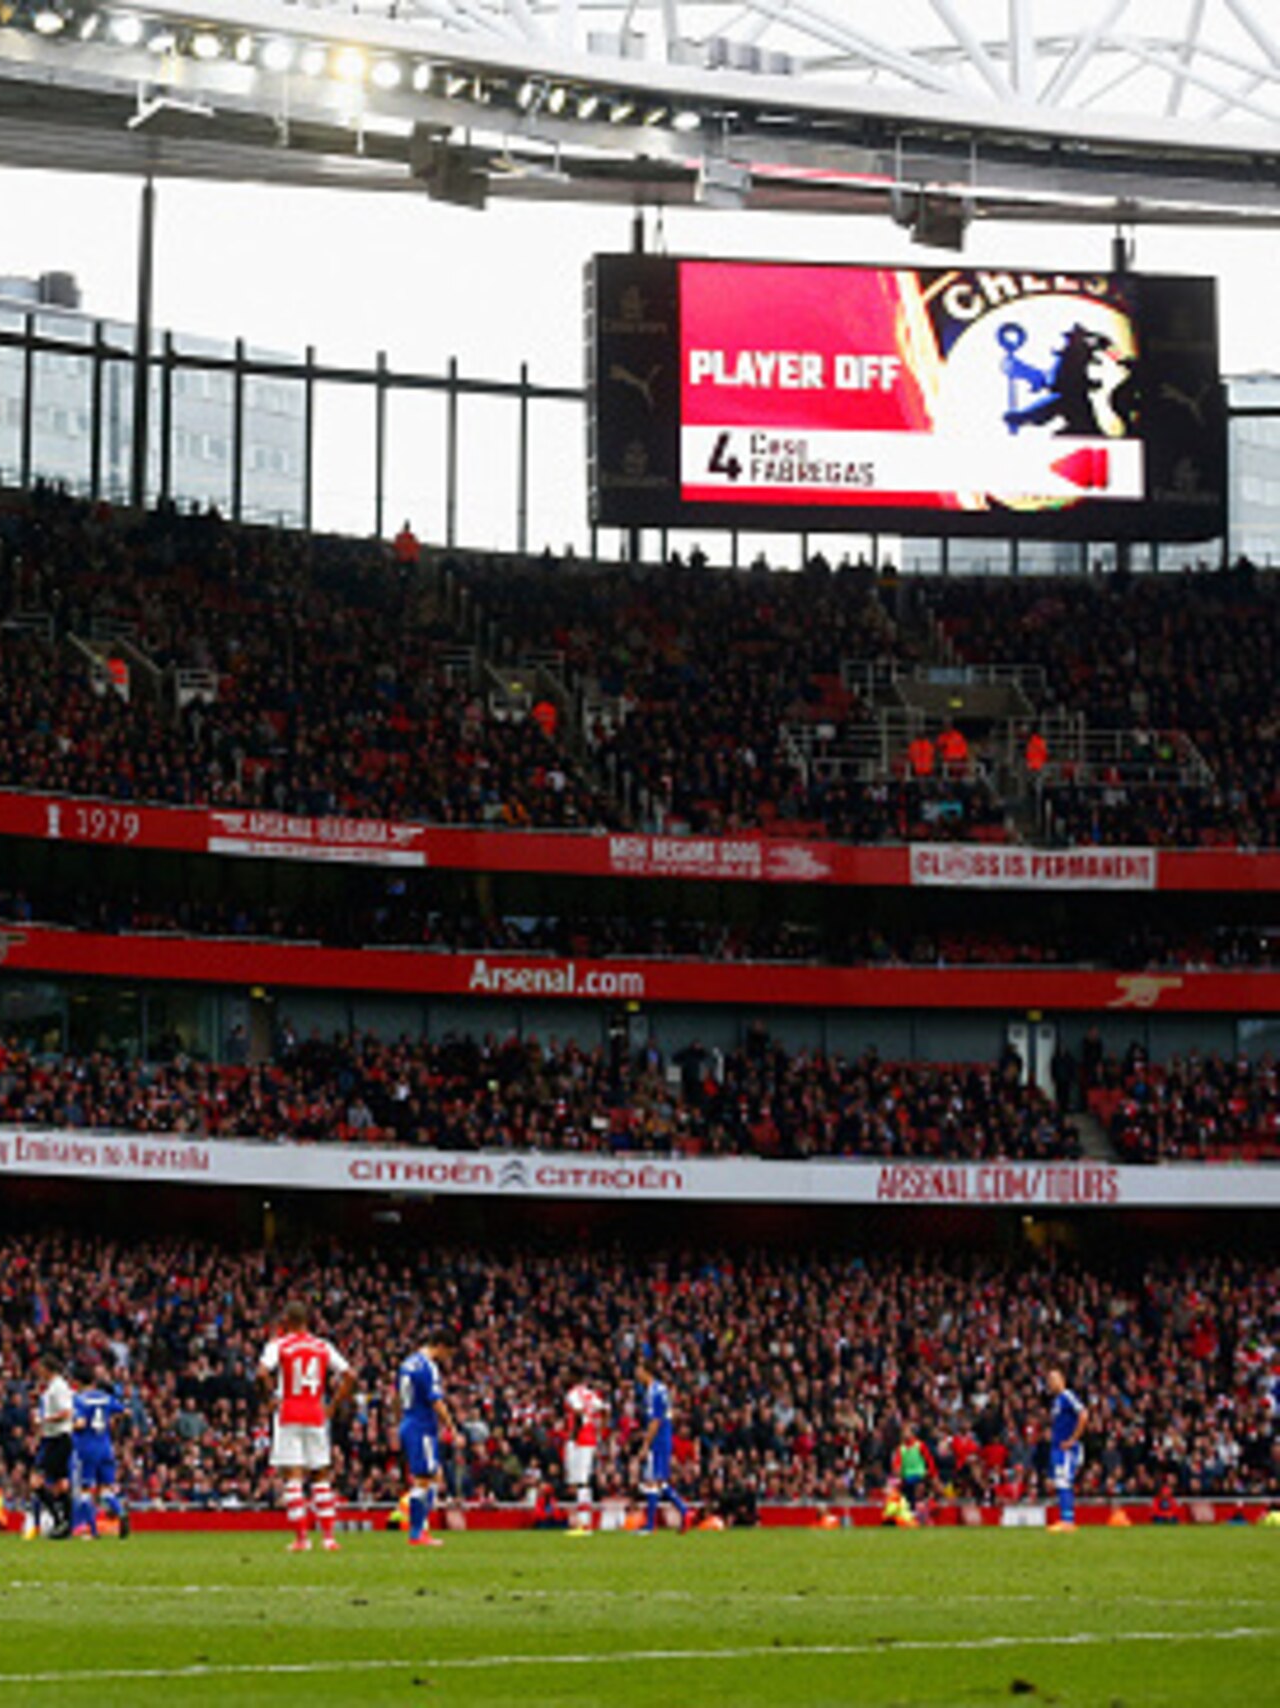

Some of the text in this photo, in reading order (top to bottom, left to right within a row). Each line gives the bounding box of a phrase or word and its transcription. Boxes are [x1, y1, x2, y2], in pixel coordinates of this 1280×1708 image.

[689, 350, 902, 391] PLAYER OFF
[708, 430, 743, 482] 4
[76, 807, 140, 842] 1979
[469, 958, 645, 997] Arsenal.com
[348, 1157, 683, 1190] CITROËN CITROËN
[291, 1355, 320, 1396] 14
